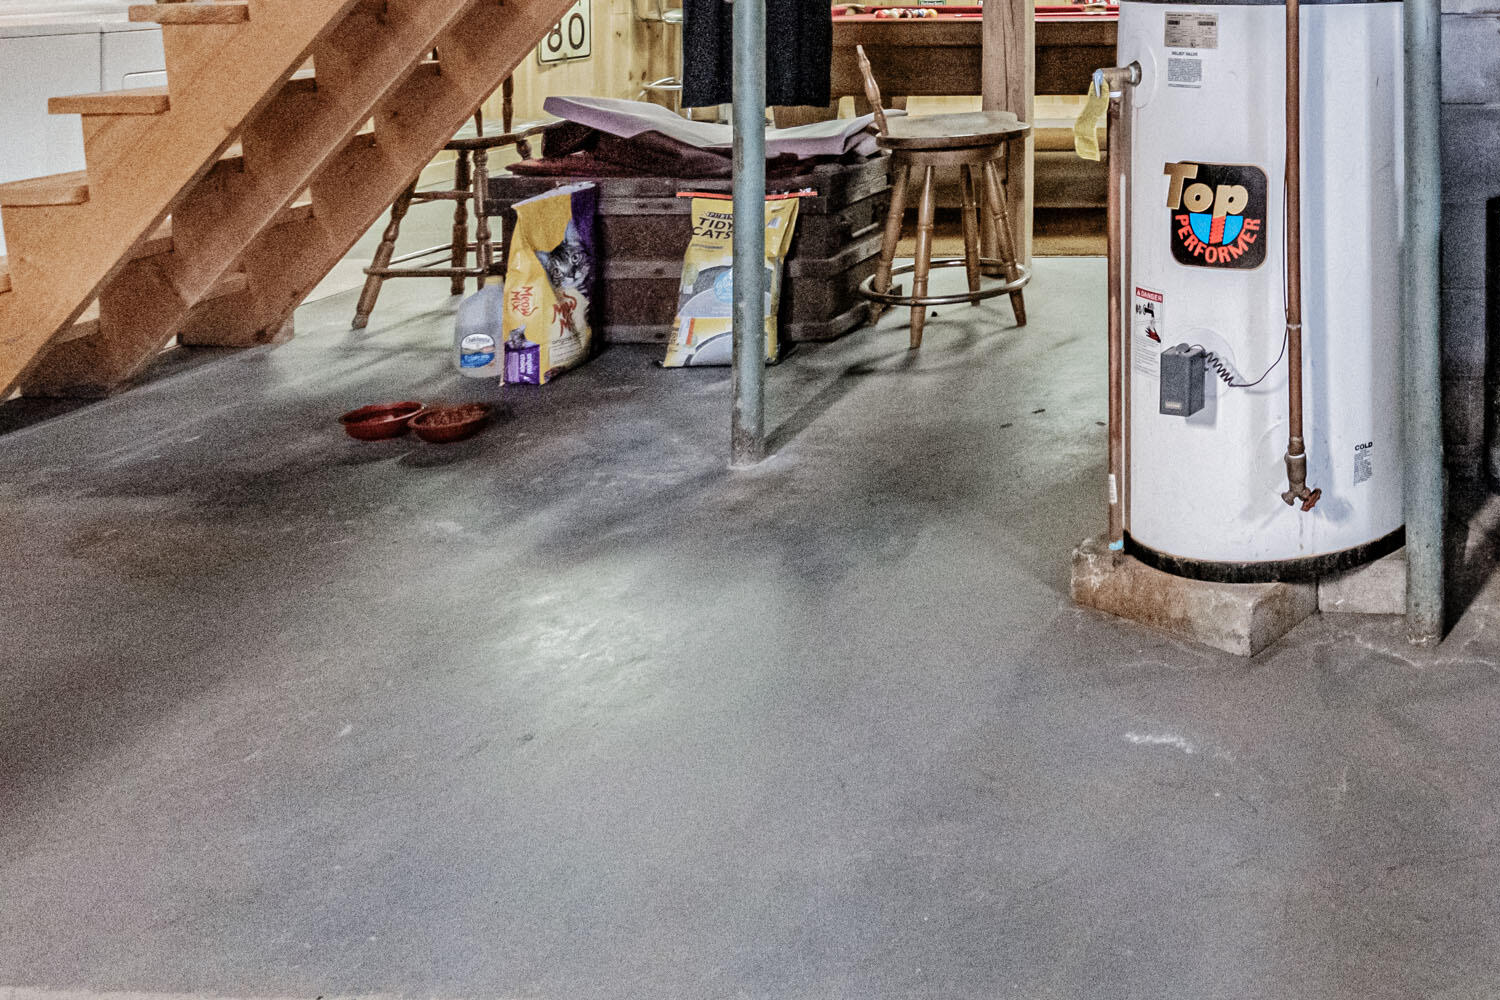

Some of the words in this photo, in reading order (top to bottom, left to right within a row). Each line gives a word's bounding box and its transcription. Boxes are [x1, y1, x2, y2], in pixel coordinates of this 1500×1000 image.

[1163, 161, 1249, 219] Top
[698, 216, 733, 230] TIDY
[692, 226, 733, 240] CATS
[1175, 214, 1261, 263] PERFORMER
[511, 290, 520, 313] Mix
[519, 286, 539, 317] Meow
[1140, 290, 1162, 301] DANGER
[1354, 441, 1373, 451] COLD
